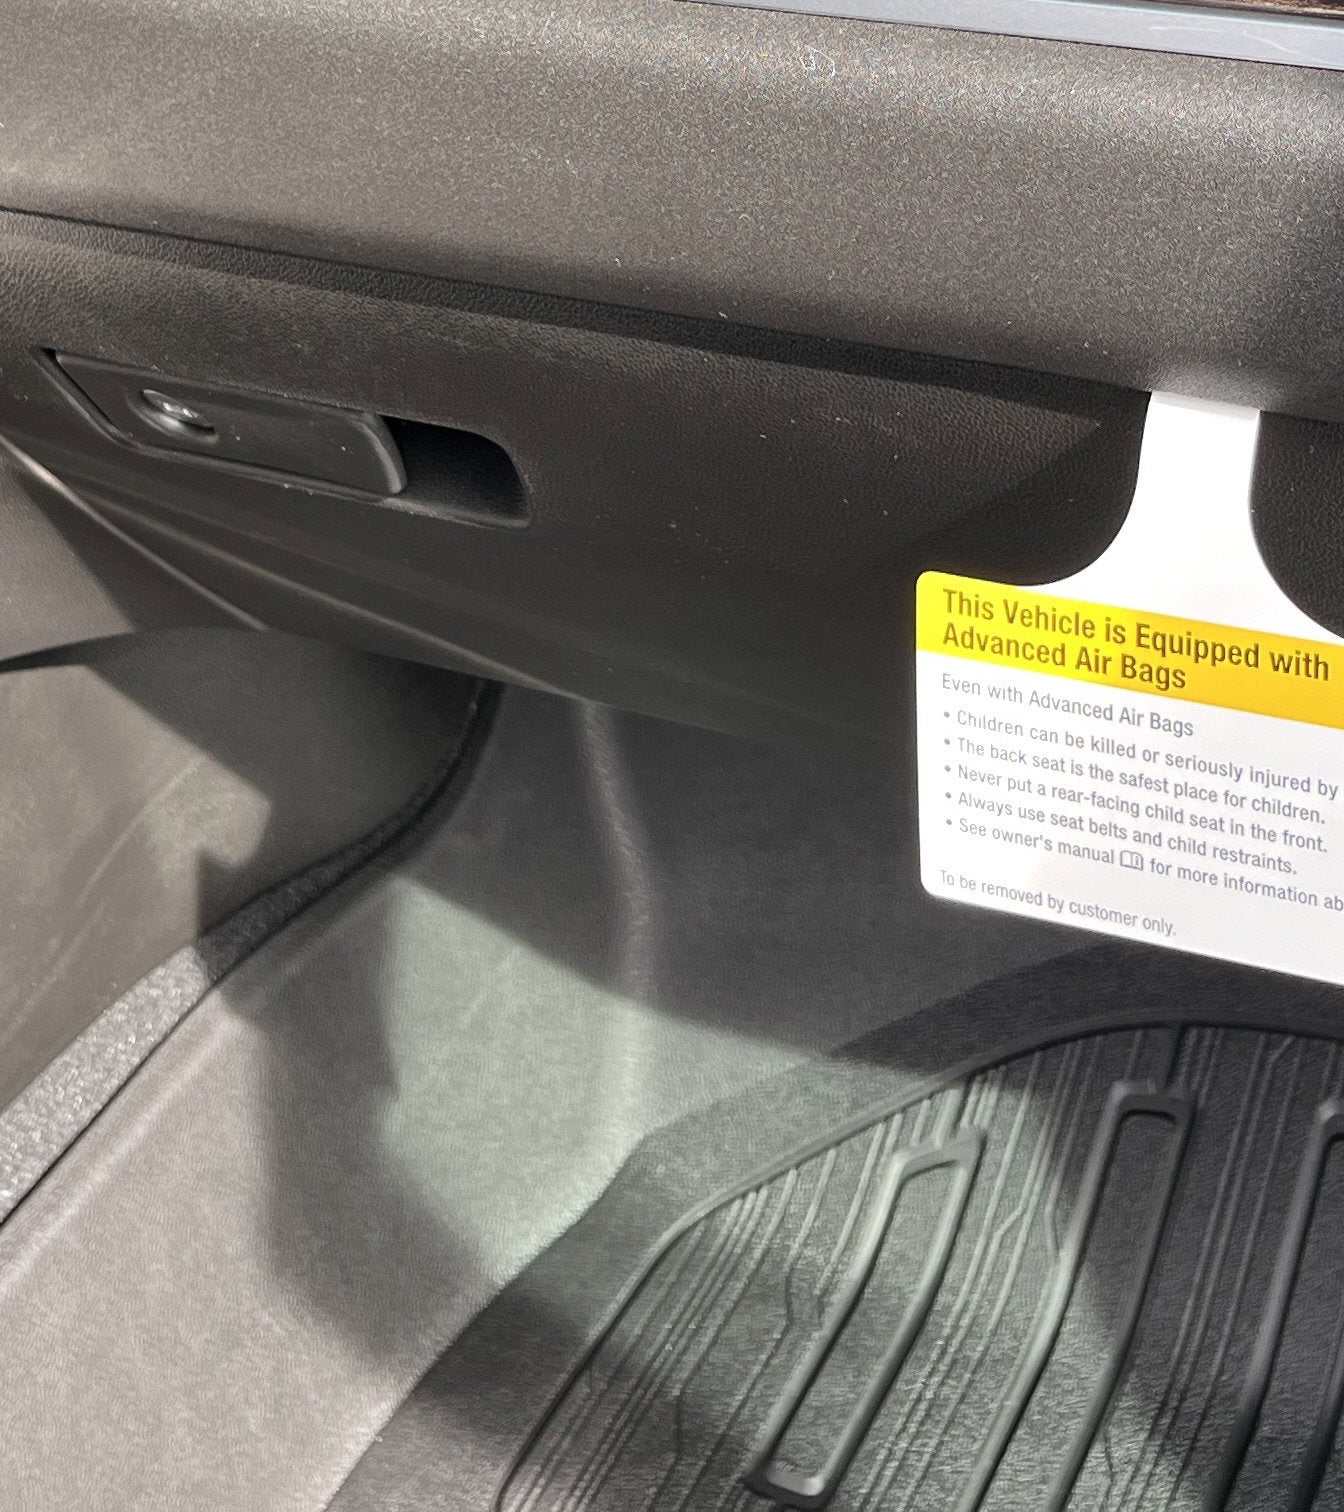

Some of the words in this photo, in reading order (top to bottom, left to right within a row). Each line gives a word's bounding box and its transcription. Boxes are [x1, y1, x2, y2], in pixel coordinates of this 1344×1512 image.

[942, 622, 1066, 667] Advanced
[1075, 645, 1112, 675] Air
[1121, 653, 1186, 692] Bags
[943, 588, 995, 620] This
[1003, 598, 1096, 639] Vehicle
[1104, 616, 1126, 644] is
[1136, 622, 1259, 670] Equipped
[1269, 648, 1330, 682] with
[942, 672, 981, 696] Even
[988, 684, 1023, 704] with
[1029, 690, 1113, 721] Advanced
[1119, 706, 1144, 727] Air
[1149, 711, 1194, 738] Bags
[957, 710, 1023, 737] Children
[1029, 725, 1058, 744] can
[1064, 730, 1085, 749] be
[1090, 735, 1136, 759] killed
[1142, 747, 1160, 763] or
[1164, 753, 1244, 782] seriously
[1249, 765, 1311, 792] injured
[1317, 778, 1338, 800] by
[958, 737, 985, 756] The
[991, 743, 1027, 765] back
[1032, 754, 1066, 773] seat
[1070, 758, 1084, 776] is
[1088, 762, 1114, 782] the
[1119, 771, 1169, 794] safest
[1174, 781, 1218, 804] place
[1223, 789, 1247, 808] for
[1251, 796, 1326, 825] children.
[958, 764, 1002, 787] Never
[1007, 776, 1032, 794] put
[1037, 784, 1046, 797] a
[1051, 786, 1140, 818] rear-facing
[1145, 803, 1184, 825] child
[1189, 814, 1225, 833] seat
[1230, 818, 1245, 837] in
[1251, 823, 1277, 843] the
[1282, 829, 1328, 853] front.
[958, 791, 1013, 818] Always
[1018, 806, 1045, 824] use
[1050, 813, 1084, 832] seat
[1089, 817, 1127, 840] belts
[1133, 828, 1163, 848] and
[1167, 834, 1206, 857] child
[1212, 844, 1298, 875] restraints.
[940, 869, 955, 886] To
[959, 874, 977, 891] be
[981, 882, 1043, 907] removed
[1047, 893, 1065, 914] by
[1069, 899, 1138, 927] customer
[1142, 915, 1177, 937] only.
[959, 818, 987, 837] See
[992, 828, 1053, 852] owner's
[1058, 842, 1115, 865] manual
[1149, 858, 1172, 877] for
[1177, 864, 1218, 886] more
[1223, 872, 1318, 907] information
